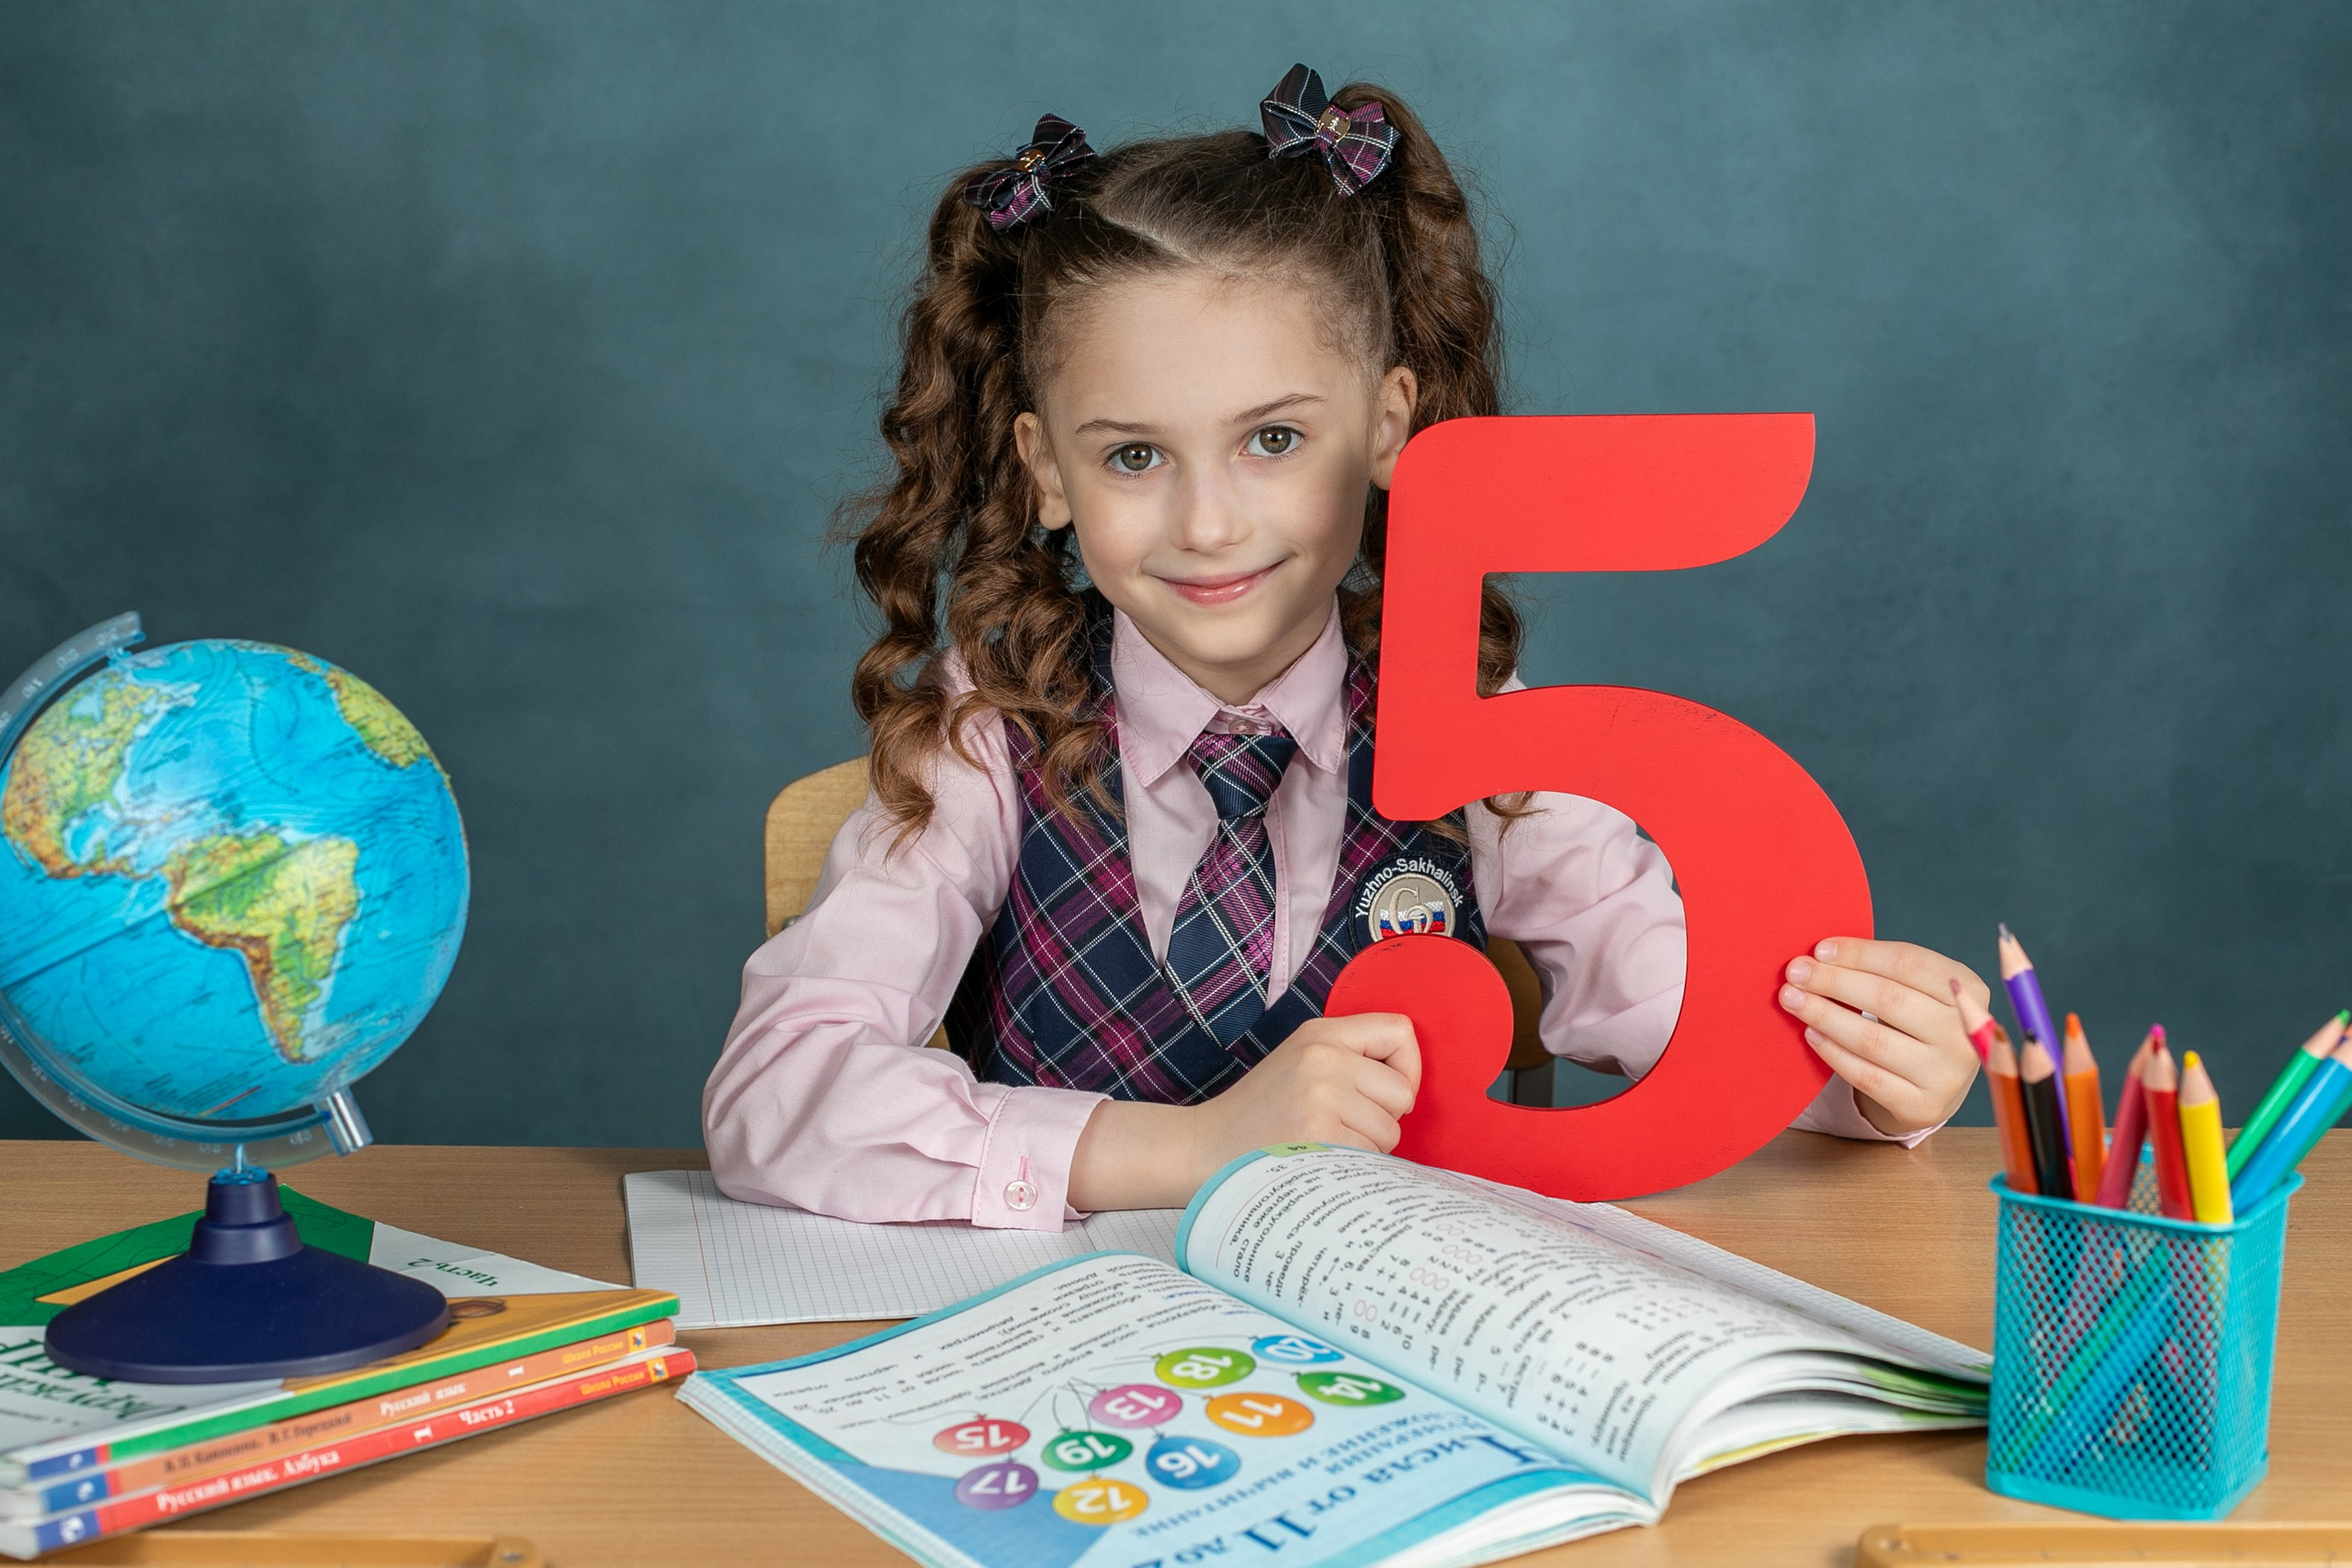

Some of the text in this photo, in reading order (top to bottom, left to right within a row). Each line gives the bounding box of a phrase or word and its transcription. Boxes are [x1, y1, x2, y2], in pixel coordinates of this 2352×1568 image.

[1324, 413, 1874, 1202] 5
[1355, 857, 1464, 918] Yuzhno-Sakhalinsk
[1251, 1186, 1298, 1230] чертеже
[1337, 1208, 1371, 1235] такие
[1241, 1181, 1324, 1284] четырёхугольнике
[1262, 1188, 1352, 1293] получилось 3 че-
[1354, 1223, 1411, 1273] равенства
[408, 1258, 499, 1286] Часть 2
[1231, 1236, 1250, 1279] стало
[1273, 1239, 1304, 1299] проведи
[1294, 1245, 1329, 1309] четырёх-
[1328, 1286, 1339, 1297] 3
[1380, 1320, 1390, 1330] 2
[1265, 1337, 1330, 1359] 20
[1399, 1331, 1415, 1351] 10
[379, 1389, 431, 1416] Русский
[435, 1383, 467, 1401] язык
[508, 1365, 525, 1377] 1
[561, 1348, 593, 1365] Школа
[593, 1340, 625, 1358] России
[1170, 1354, 1233, 1381] 18
[1317, 1377, 1383, 1400] 14
[1104, 1391, 1166, 1421] 13
[1222, 1399, 1283, 1428] 11
[155, 1371, 647, 1512] Русский язык. Азбука 1 Часть 2 Школа России
[955, 1425, 1011, 1450] 15
[1056, 1436, 1116, 1465] 19
[1157, 1445, 1221, 1478] 16
[969, 1471, 1028, 1495] 17
[1175, 1433, 1542, 1563] Числа от 11 до
[1071, 1486, 1133, 1513] 12
[1133, 1469, 1292, 1540] ВЫЧИТАНИЕ
